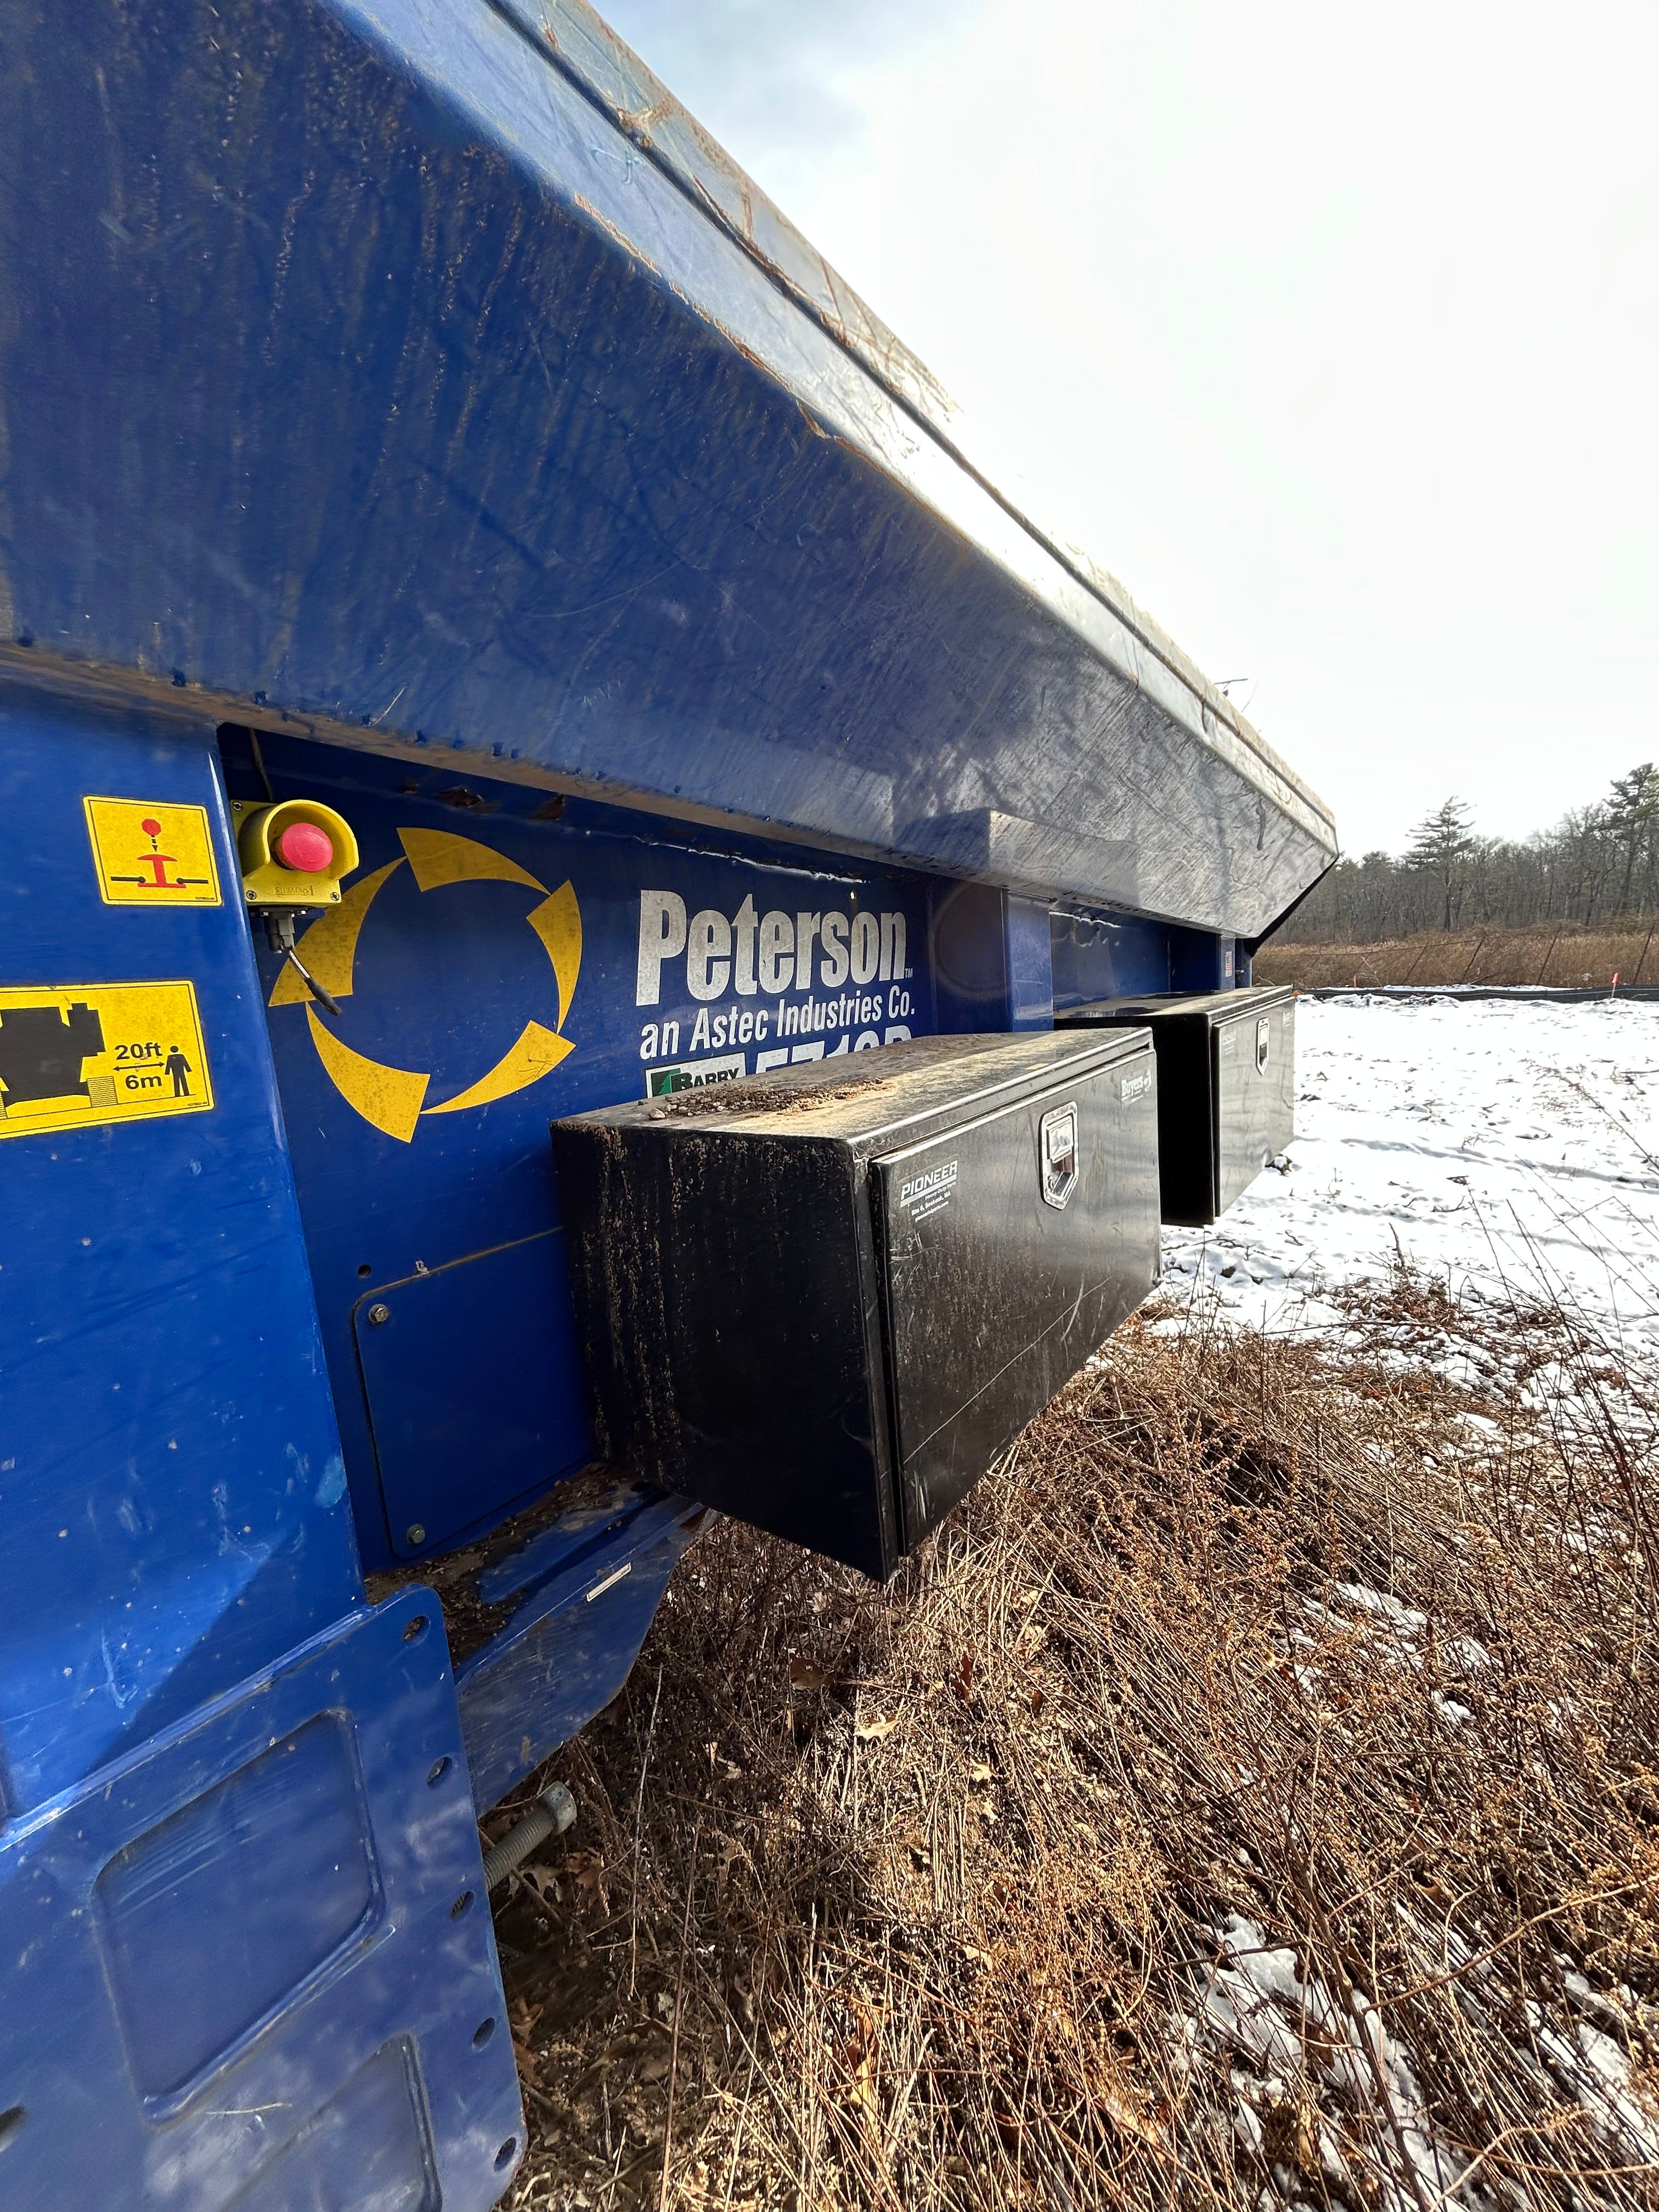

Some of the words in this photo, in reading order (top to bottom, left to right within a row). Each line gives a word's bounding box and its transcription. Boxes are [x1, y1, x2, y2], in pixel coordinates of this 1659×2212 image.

[636, 889, 906, 1006] Peterson
[905, 968, 913, 978] TM
[640, 1020, 679, 1060] an
[689, 1007, 769, 1052] Astec
[777, 993, 882, 1037] Industries
[888, 985, 915, 1017] Co.
[114, 1042, 163, 1060] 20ft
[125, 1074, 162, 1090] 6m
[1121, 1075, 1143, 1097] Buyers
[901, 1160, 958, 1200] PIONEER
